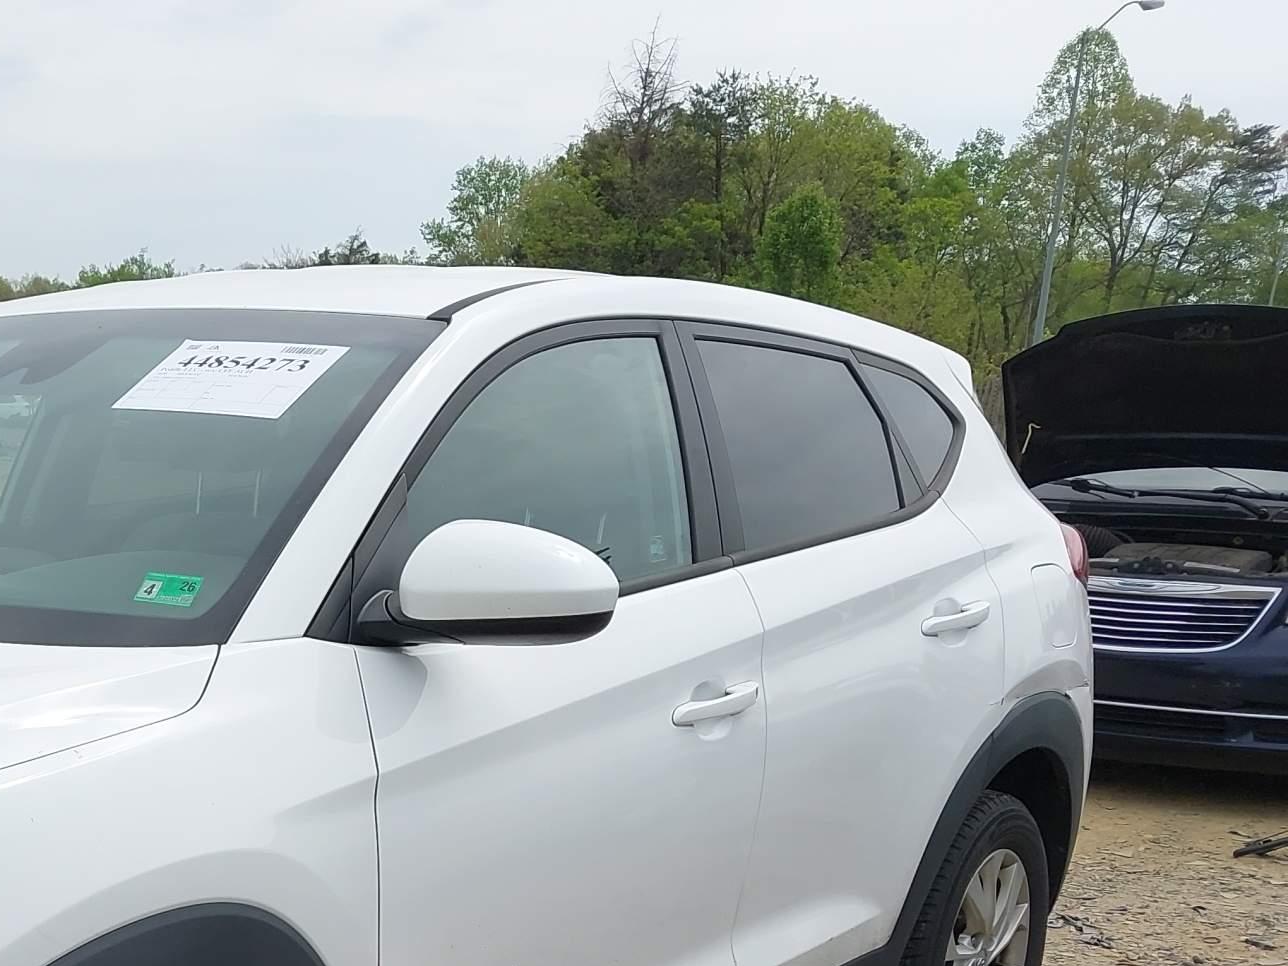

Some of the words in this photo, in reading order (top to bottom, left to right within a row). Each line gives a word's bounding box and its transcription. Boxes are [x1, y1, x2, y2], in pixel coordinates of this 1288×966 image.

[178, 355, 310, 373] 44854273
[143, 583, 157, 596] 4
[179, 581, 197, 593] 26
